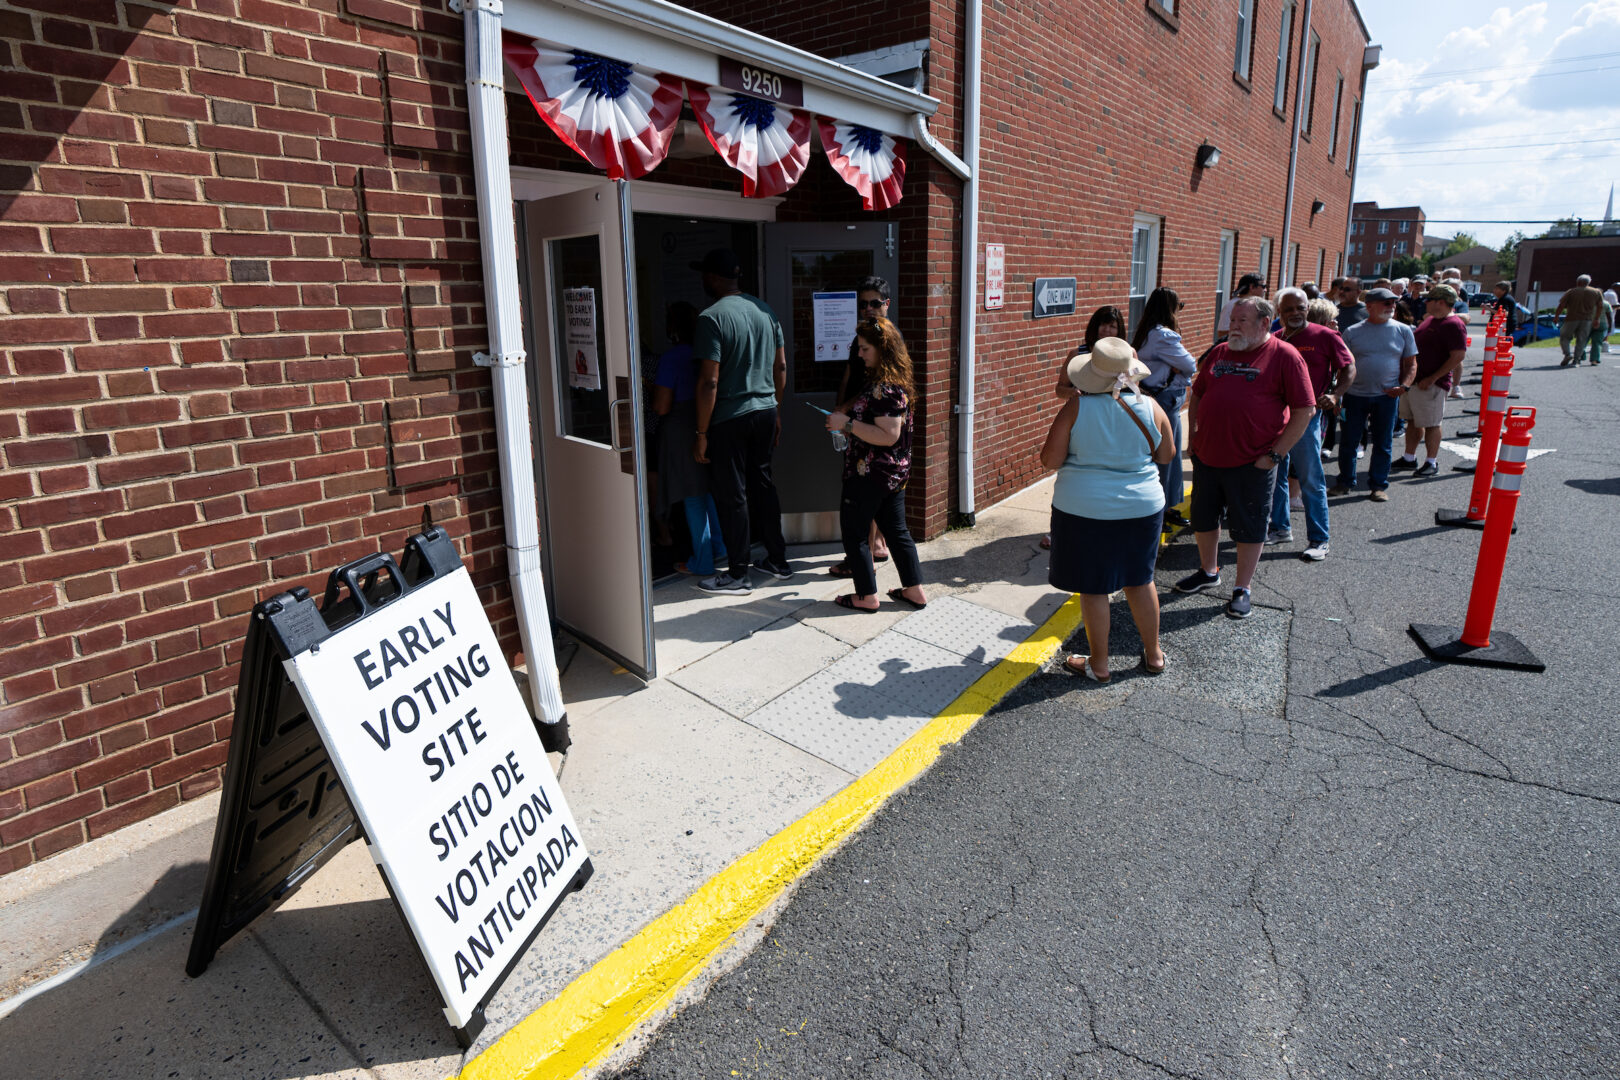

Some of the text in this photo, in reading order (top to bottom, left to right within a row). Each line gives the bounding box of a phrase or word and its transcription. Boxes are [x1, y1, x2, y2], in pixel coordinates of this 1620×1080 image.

[741, 66, 782, 99] 9250
[567, 304, 592, 314] TO EARLY
[1047, 288, 1072, 304] ONE WAY
[354, 602, 457, 691] EARLY
[361, 644, 491, 751] VOTING
[422, 708, 488, 783] SITE
[429, 751, 525, 861] SITIO DE
[435, 785, 553, 924] VOTACION
[455, 824, 579, 994] ANTICIPADA
